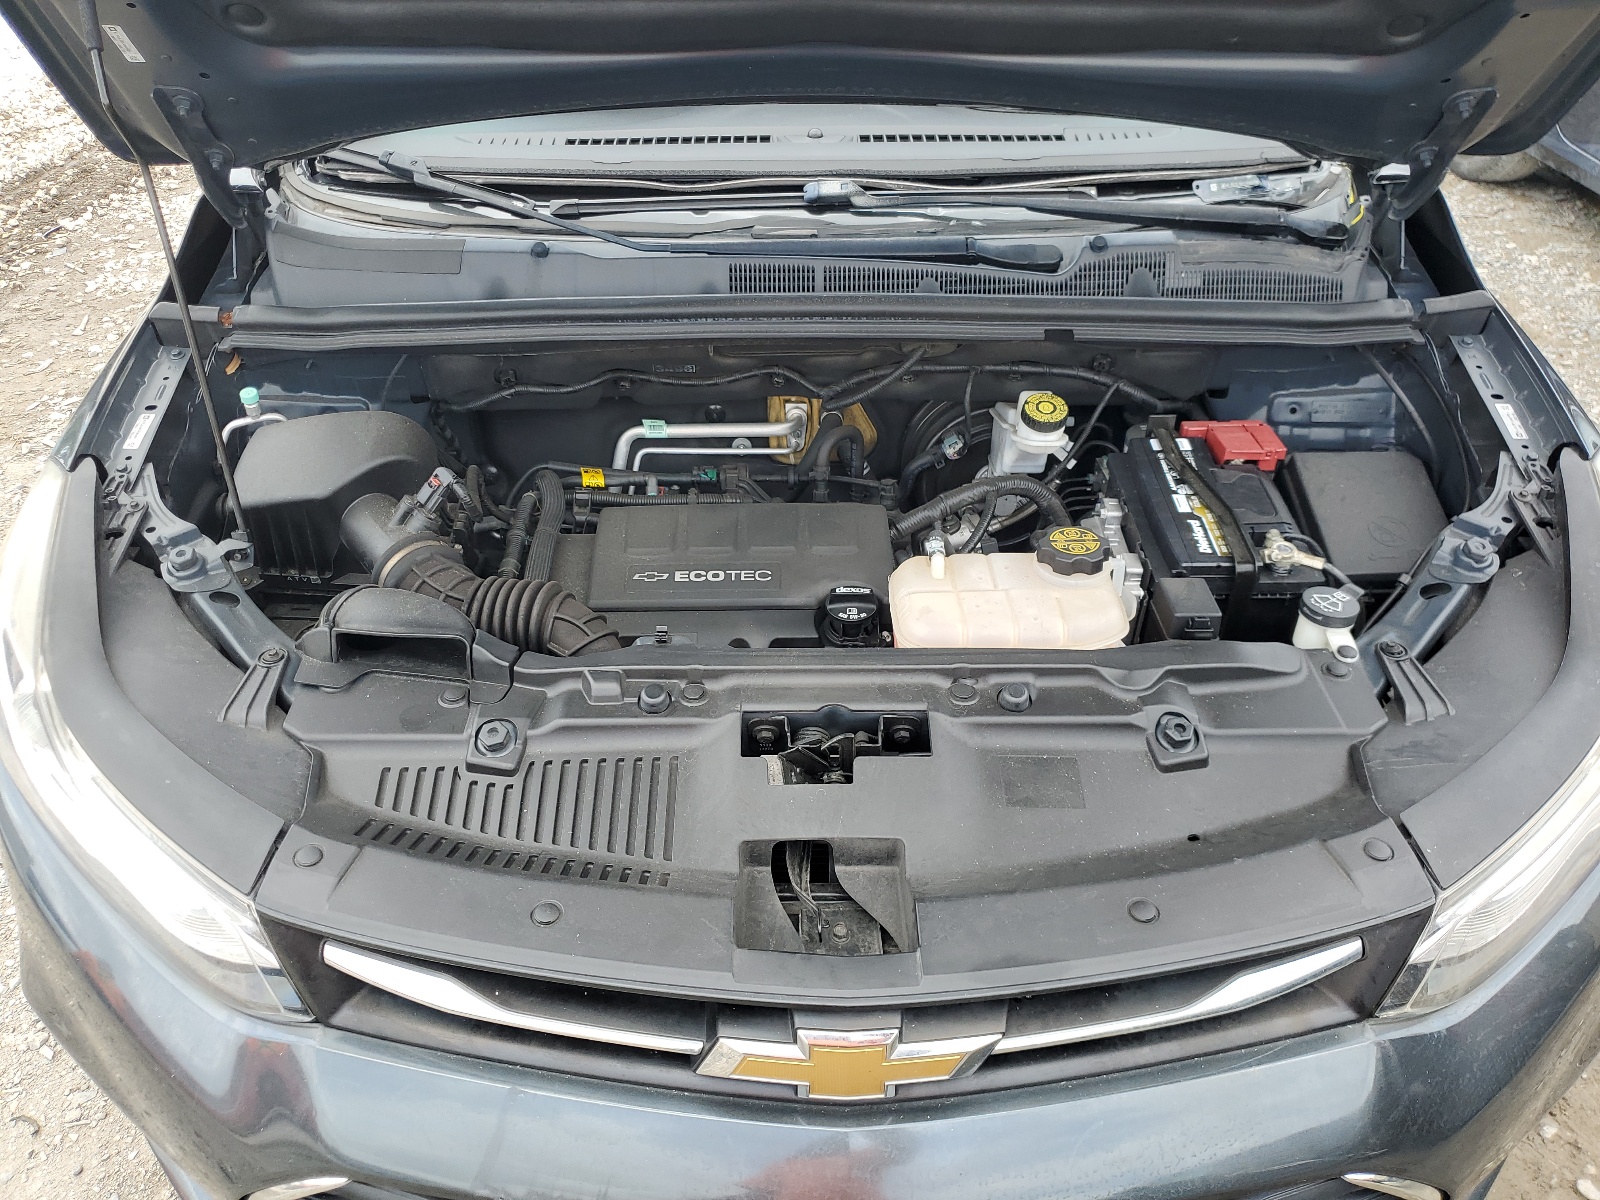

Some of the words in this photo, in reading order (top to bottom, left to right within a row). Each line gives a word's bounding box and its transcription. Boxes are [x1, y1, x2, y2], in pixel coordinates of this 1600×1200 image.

[1187, 519, 1213, 554] DieHard
[674, 570, 772, 582] ECOTEC
[835, 586, 872, 594] dexos
